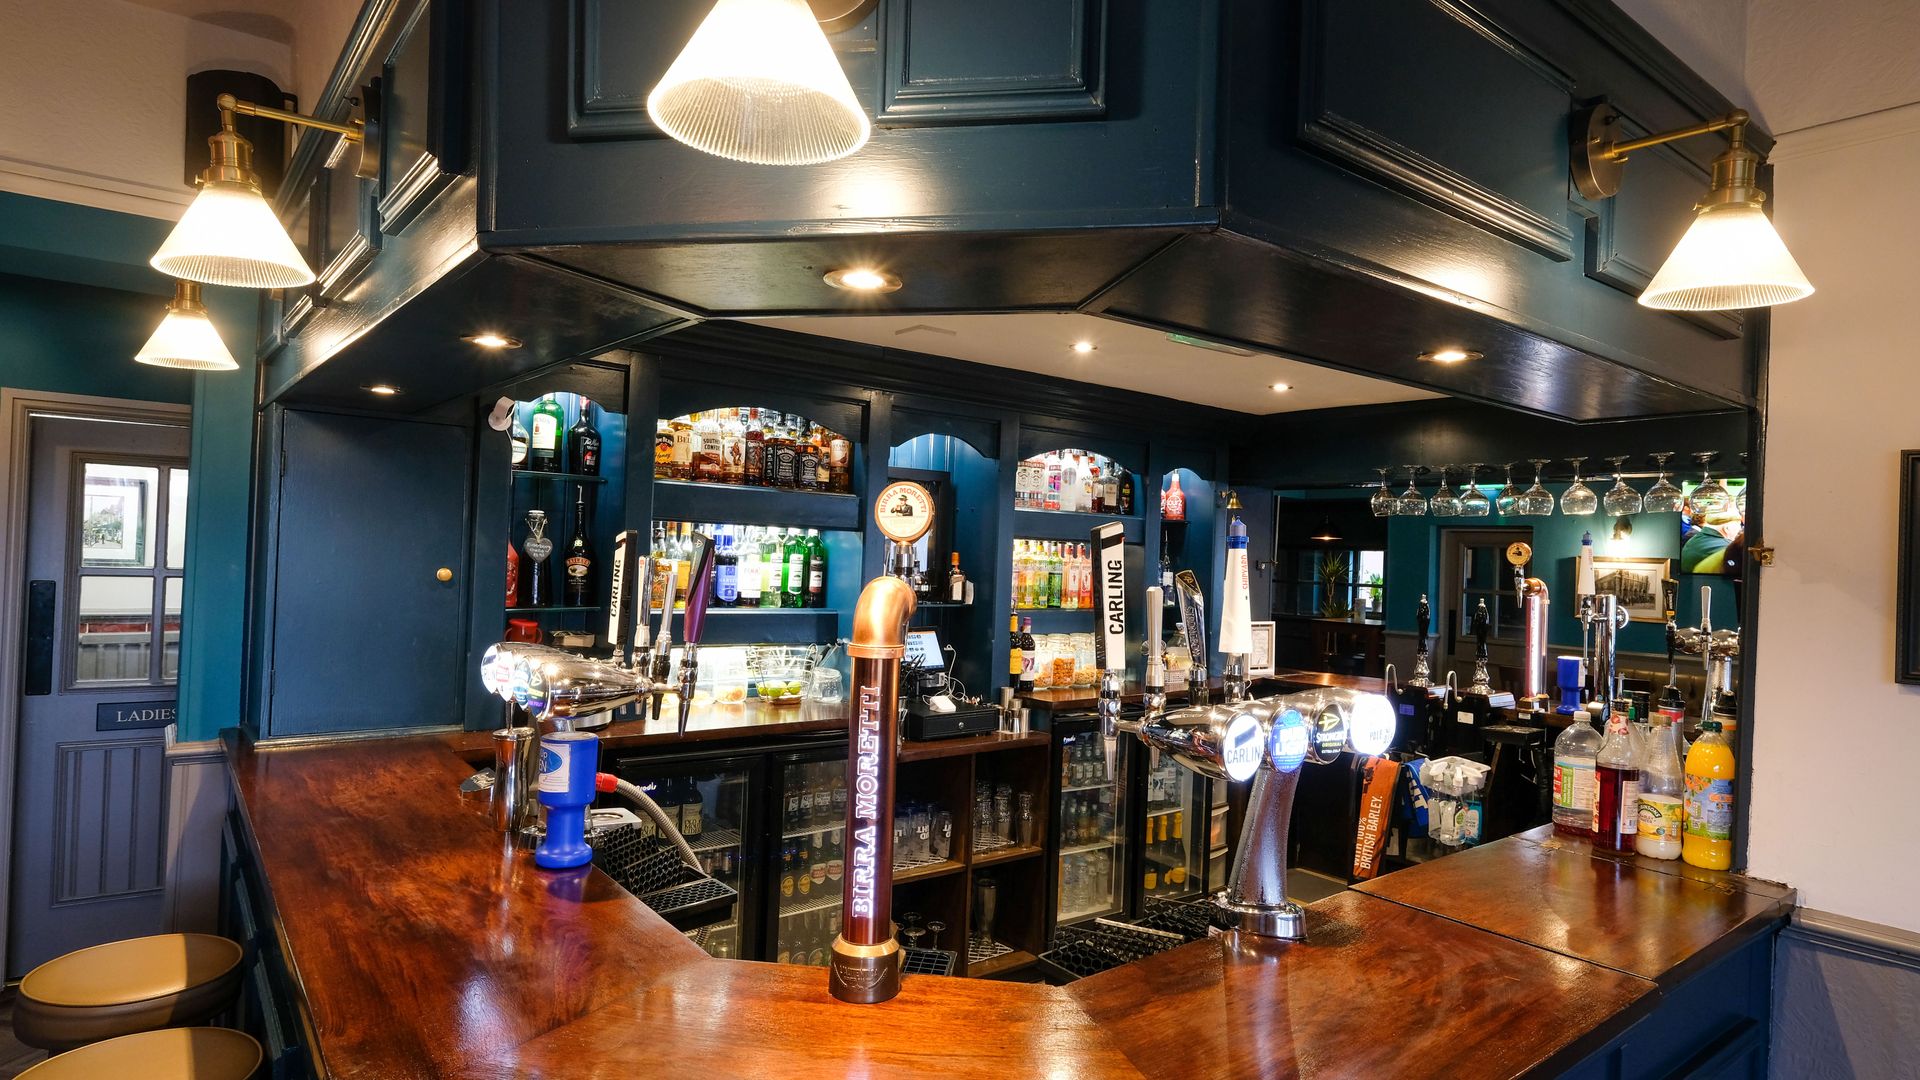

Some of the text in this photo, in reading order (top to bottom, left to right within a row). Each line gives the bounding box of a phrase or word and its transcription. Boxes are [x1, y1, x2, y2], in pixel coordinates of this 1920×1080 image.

[880, 487, 927, 513] BIRRA MORETTI
[610, 559, 622, 618] CARLING
[1107, 559, 1124, 635] CARLING
[1227, 745, 1263, 765] CARLIN
[851, 685, 880, 919] BIRRA MORETTI
[1360, 795, 1383, 870] BRITISH BARLEY.
